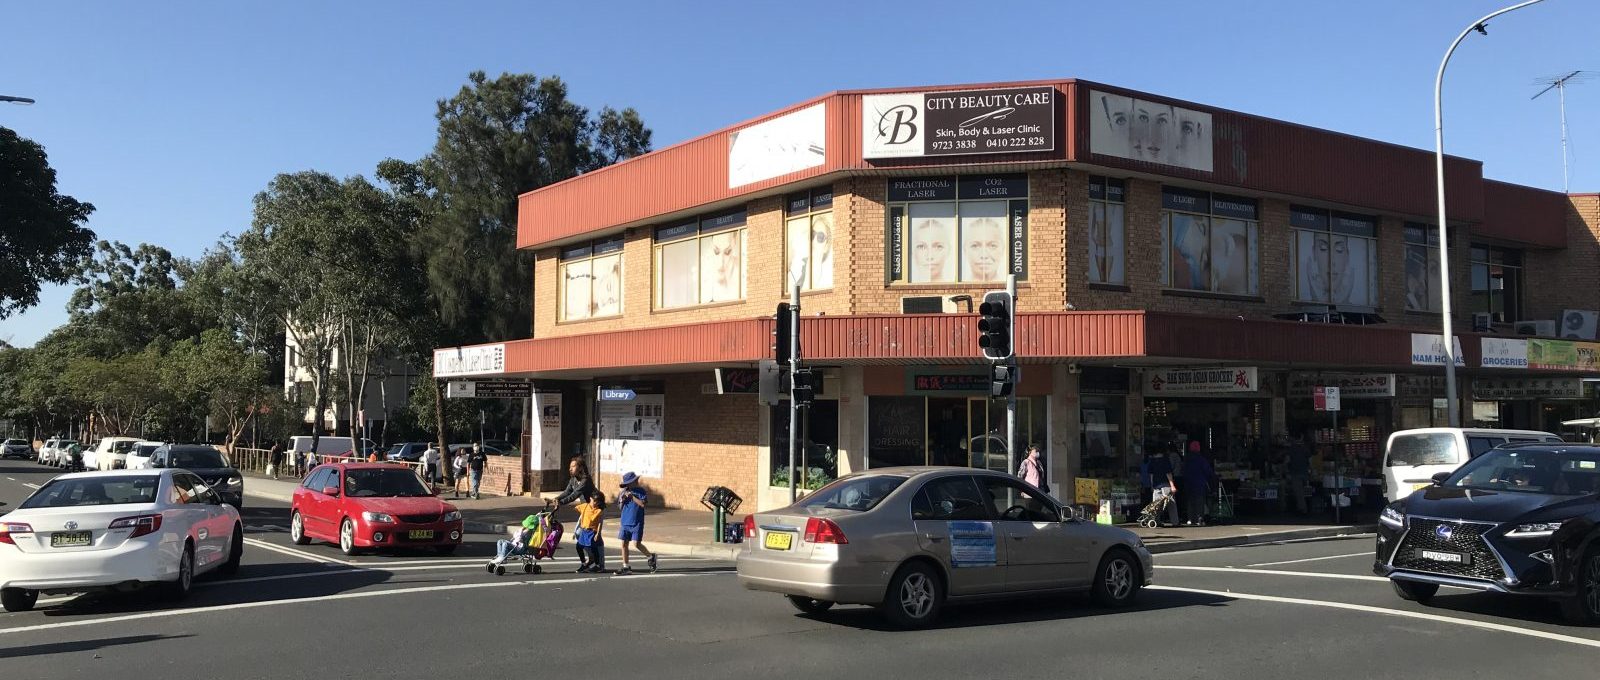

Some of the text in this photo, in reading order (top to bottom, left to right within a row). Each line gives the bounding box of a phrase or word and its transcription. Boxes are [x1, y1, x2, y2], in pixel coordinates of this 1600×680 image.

[926, 92, 1050, 110] CITY BEAUTY CARE
[936, 124, 1041, 138] Skin, Body & Laser Clinic
[932, 136, 1045, 150] 9723 3838 0410 222 828
[894, 180, 950, 189] FRACTIONAL
[907, 190, 936, 198] LASER
[979, 187, 1008, 196] LASER
[893, 216, 901, 274] SPECIALISTS
[1014, 209, 1023, 273] LASER CLINIC
[1412, 354, 1433, 363] NAM
[1483, 357, 1528, 366] GROCERIES
[605, 391, 630, 400] Library
